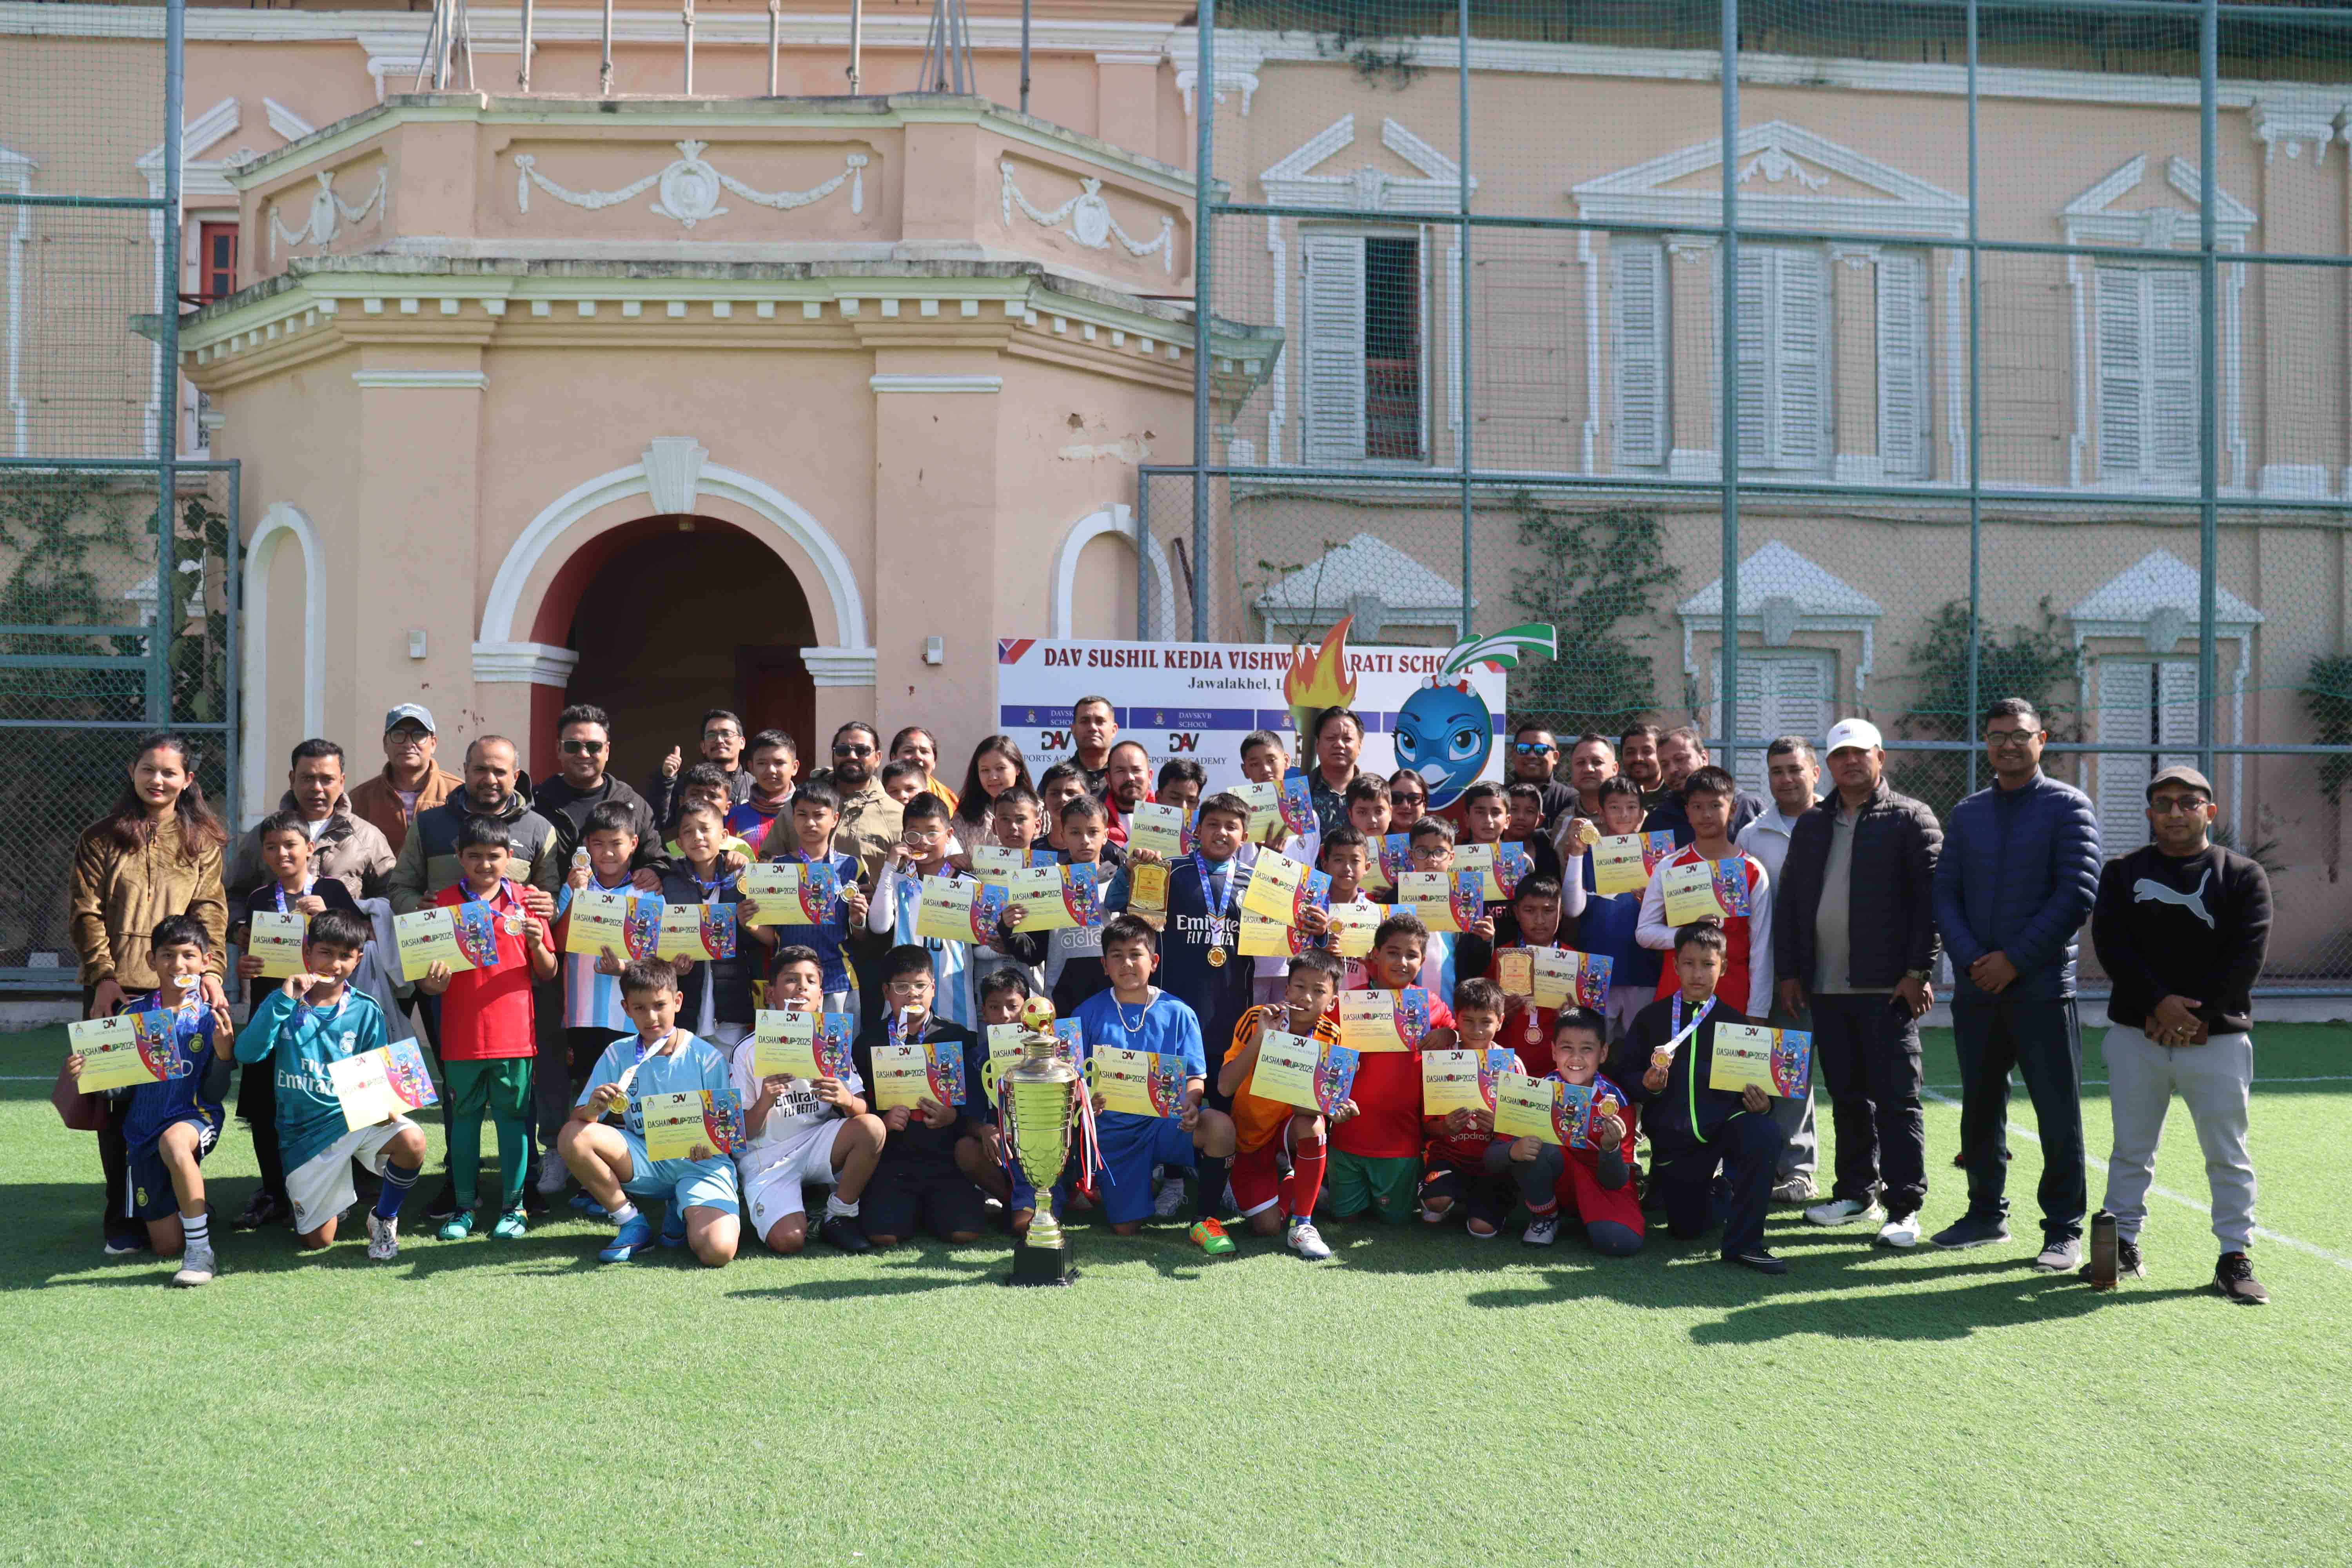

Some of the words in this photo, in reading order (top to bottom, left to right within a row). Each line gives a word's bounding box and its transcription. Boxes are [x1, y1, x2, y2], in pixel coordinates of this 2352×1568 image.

[1044, 648, 1082, 666] DAV
[1087, 649, 1158, 668] SUSHIL
[1164, 650, 1223, 669] KEDIA
[1228, 651, 1293, 670] VISHW
[1188, 677, 1271, 691] Jawalakhel,
[1041, 731, 1073, 750] DAV
[1169, 733, 1200, 752] DAV
[1035, 869, 1047, 877] DAV
[602, 895, 615, 903] DAV
[1013, 893, 1034, 901] DASHAIN
[923, 899, 944, 907] DASHAIN
[423, 910, 436, 920] DAV
[574, 913, 595, 923] DASHAIN
[1243, 915, 1263, 924] DASHAIN
[401, 936, 425, 948] DASHAIN
[1187, 931, 1201, 944] FLY
[786, 1013, 800, 1022] DAV
[103, 1019, 117, 1029] DAV
[1017, 1024, 1029, 1033] DAV
[1746, 1027, 1759, 1036] DAV
[1293, 1037, 1308, 1047] DAV
[899, 1047, 911, 1056] DAV
[993, 1049, 1014, 1058] DASHAIN
[1122, 1051, 1135, 1060] DAV
[1451, 1052, 1463, 1060] DAV
[1717, 1048, 1739, 1057] DASHAIN
[1261, 1054, 1285, 1066] DASHAIN
[1100, 1071, 1117, 1079] ASHAIN
[1527, 1078, 1541, 1088] DAV
[673, 1094, 686, 1103] DAV
[1500, 1095, 1522, 1106] DASHAIN
[797, 1101, 819, 1114] BETTER
[648, 1118, 672, 1128] DASHAIN
